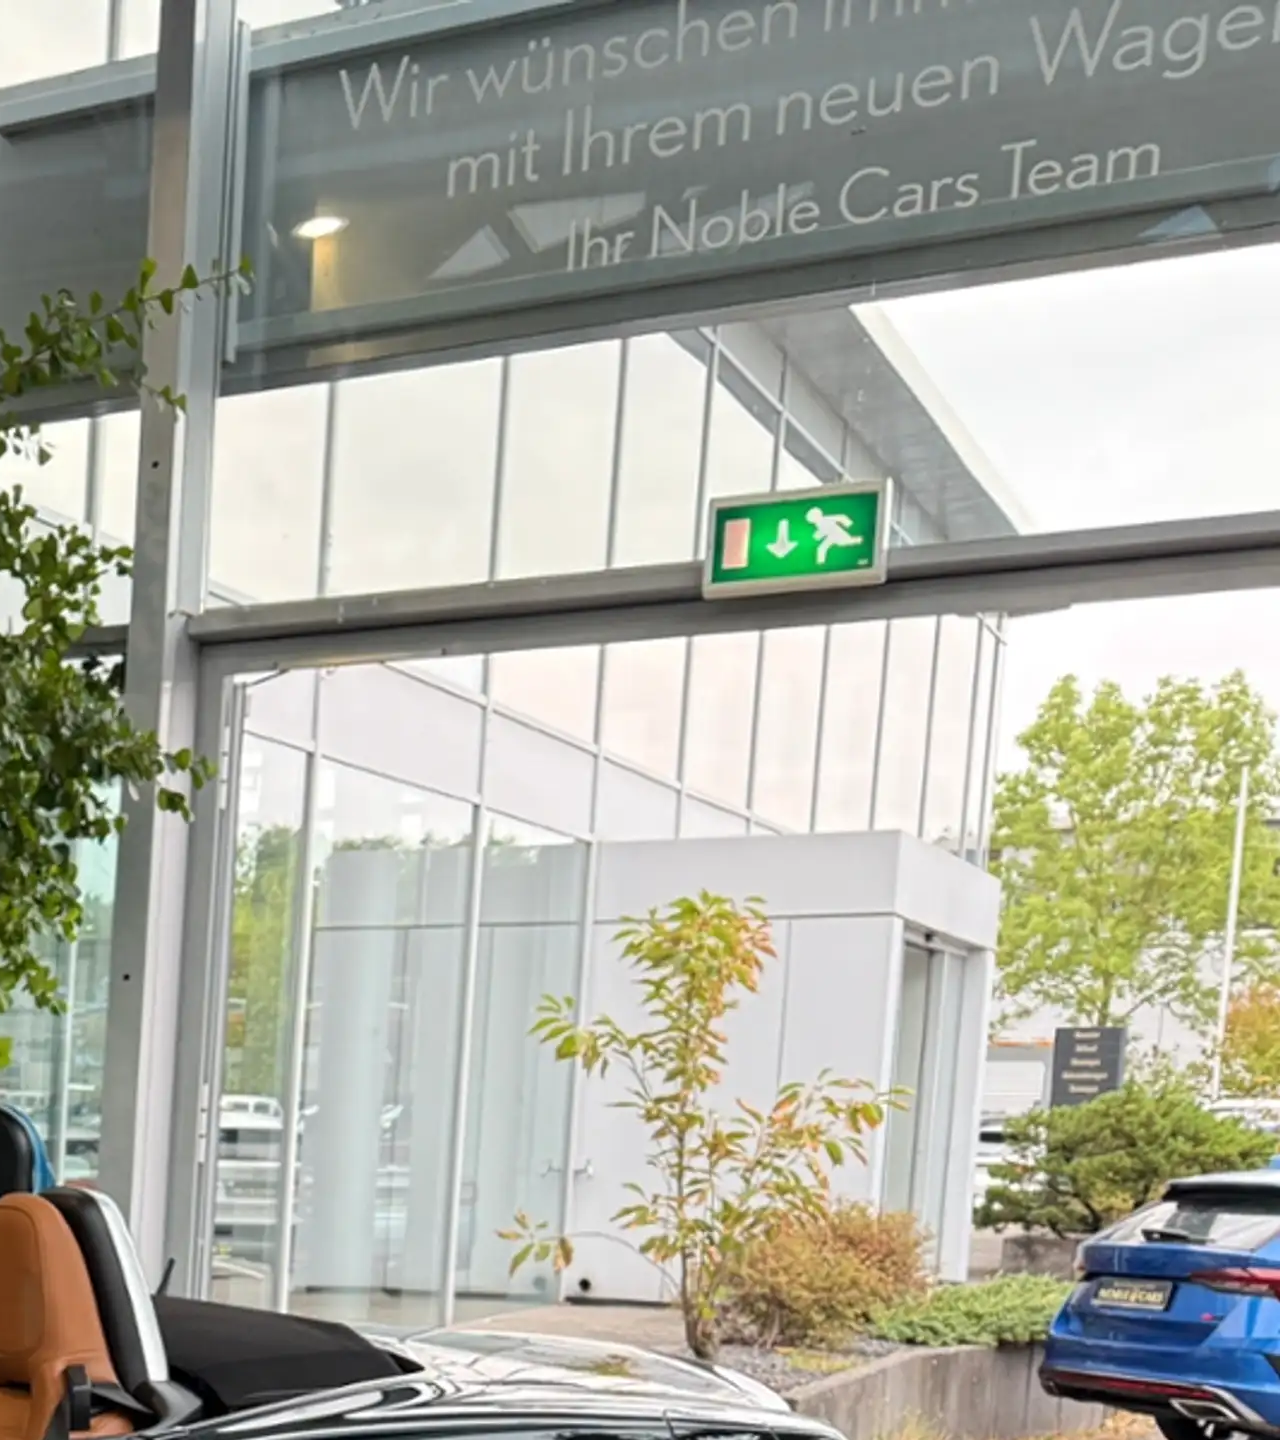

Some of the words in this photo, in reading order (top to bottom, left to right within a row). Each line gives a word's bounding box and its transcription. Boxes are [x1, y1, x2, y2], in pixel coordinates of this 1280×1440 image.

[339, 55, 449, 130] Wir
[465, 0, 800, 104] wünschen
[446, 128, 541, 198] mit
[562, 100, 752, 177] Ihrem
[775, 53, 1000, 136] neuen
[1028, 0, 1280, 86] Wage
[566, 217, 635, 272] Ihr
[650, 182, 821, 259] Noble
[839, 165, 980, 225] Cars
[1000, 138, 1161, 201] Team
